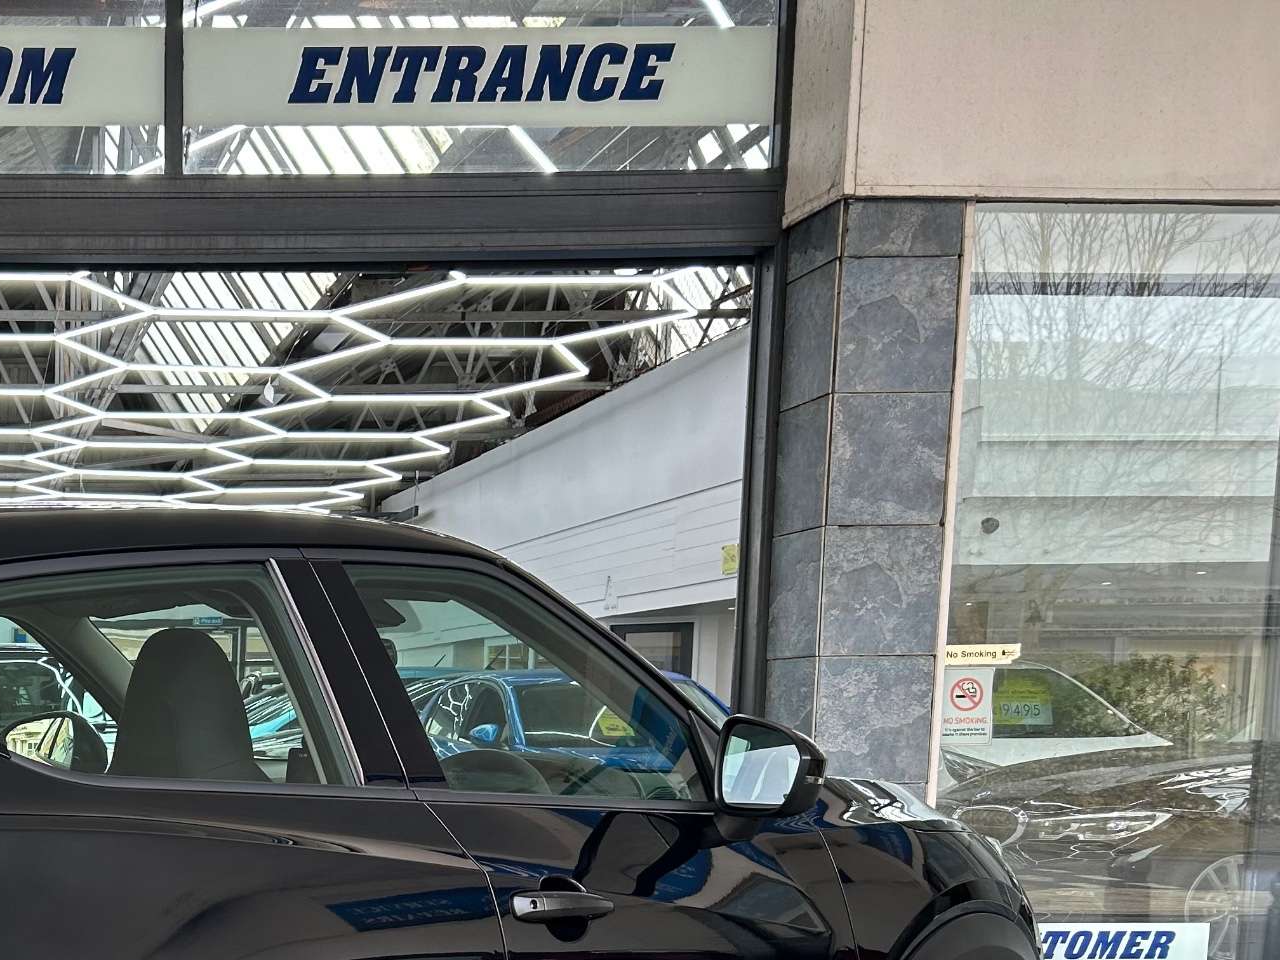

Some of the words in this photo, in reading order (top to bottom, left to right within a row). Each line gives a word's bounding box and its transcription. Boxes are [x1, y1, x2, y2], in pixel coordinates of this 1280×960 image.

[287, 42, 677, 104] ENTRANCE
[960, 650, 997, 659] Smoking
[1040, 930, 1177, 960] TOMER
